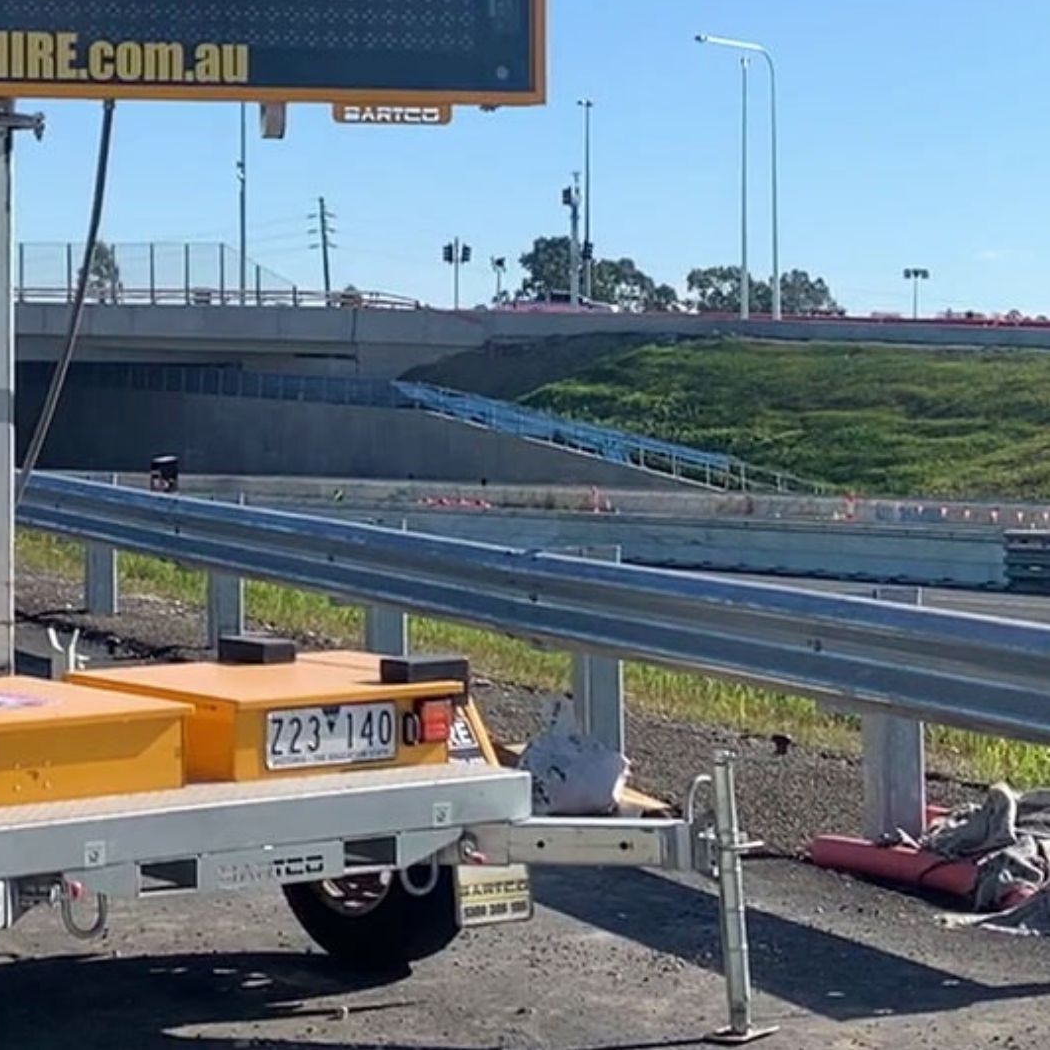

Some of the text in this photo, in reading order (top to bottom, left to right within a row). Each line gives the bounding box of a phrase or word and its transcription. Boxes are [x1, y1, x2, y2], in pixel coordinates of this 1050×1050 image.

[344, 106, 440, 122] BARTCO
[271, 709, 392, 756] Z23 140
